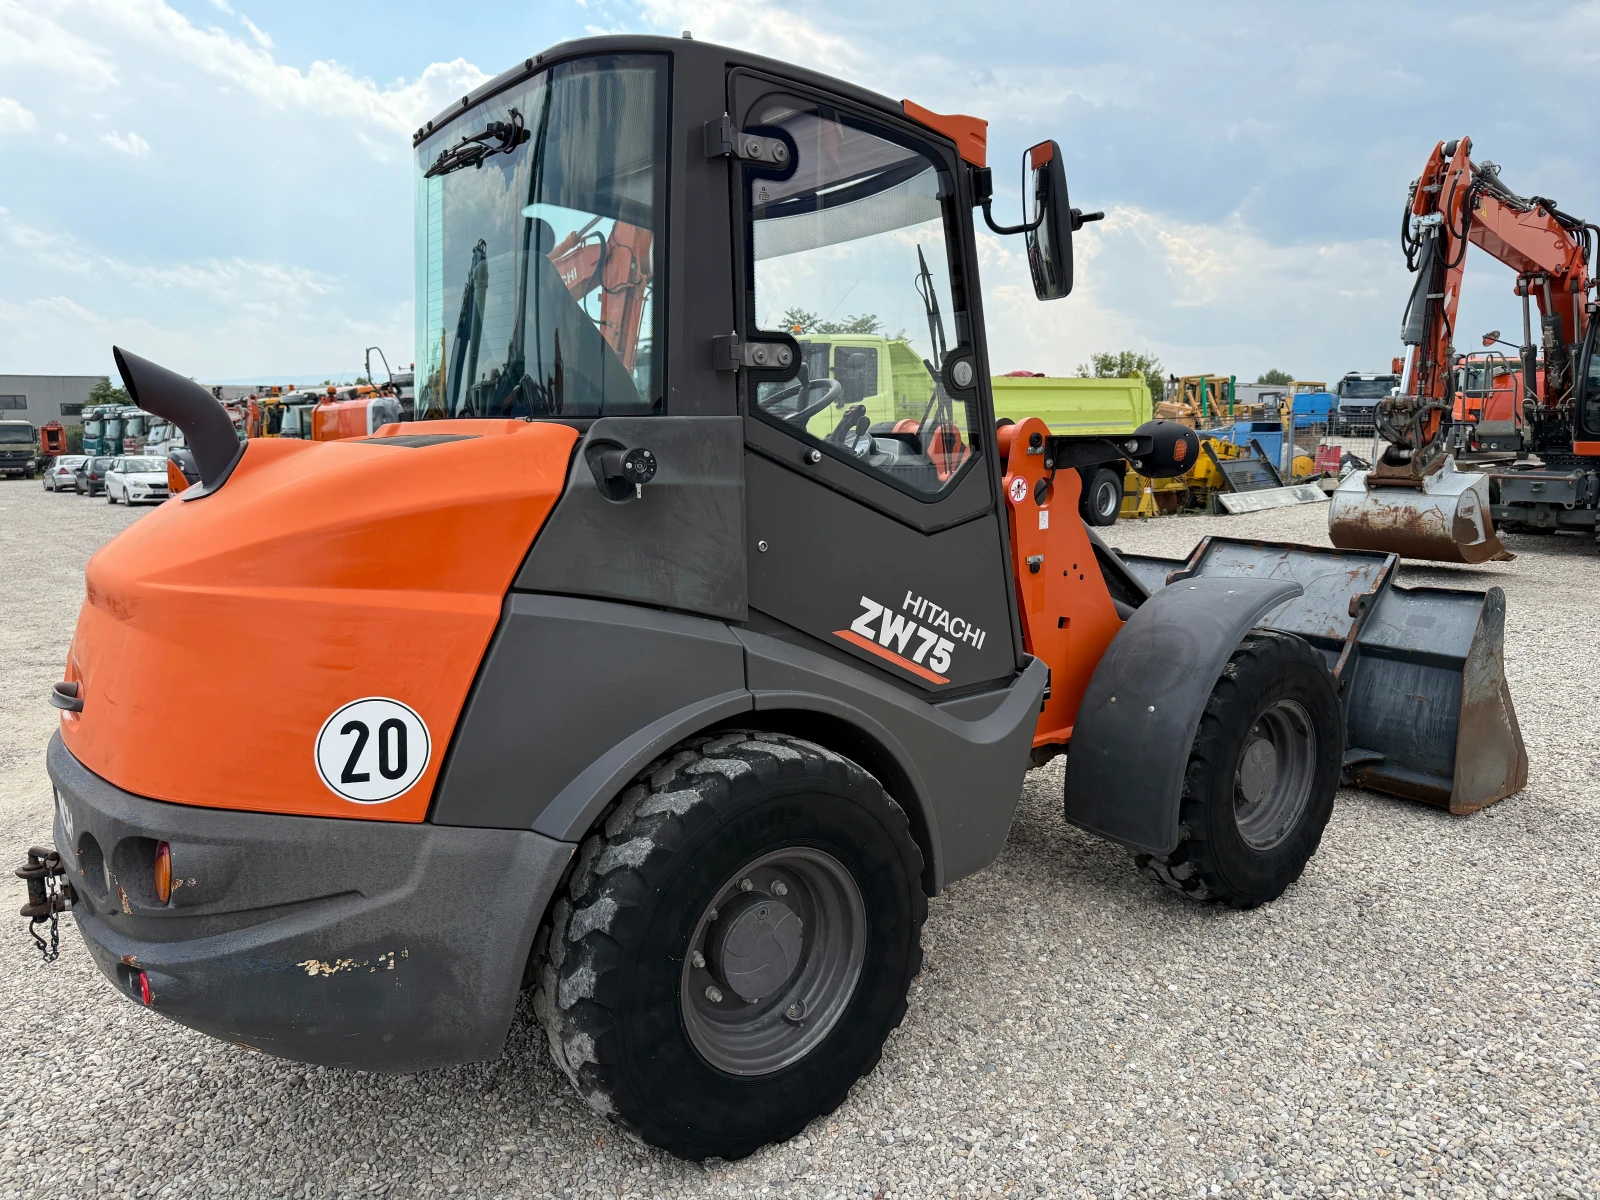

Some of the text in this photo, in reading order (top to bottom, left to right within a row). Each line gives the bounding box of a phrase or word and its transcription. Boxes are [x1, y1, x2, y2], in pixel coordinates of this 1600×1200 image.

[850, 596, 956, 674] ZW75
[902, 590, 986, 650] HITACHI
[340, 718, 408, 784] 20
